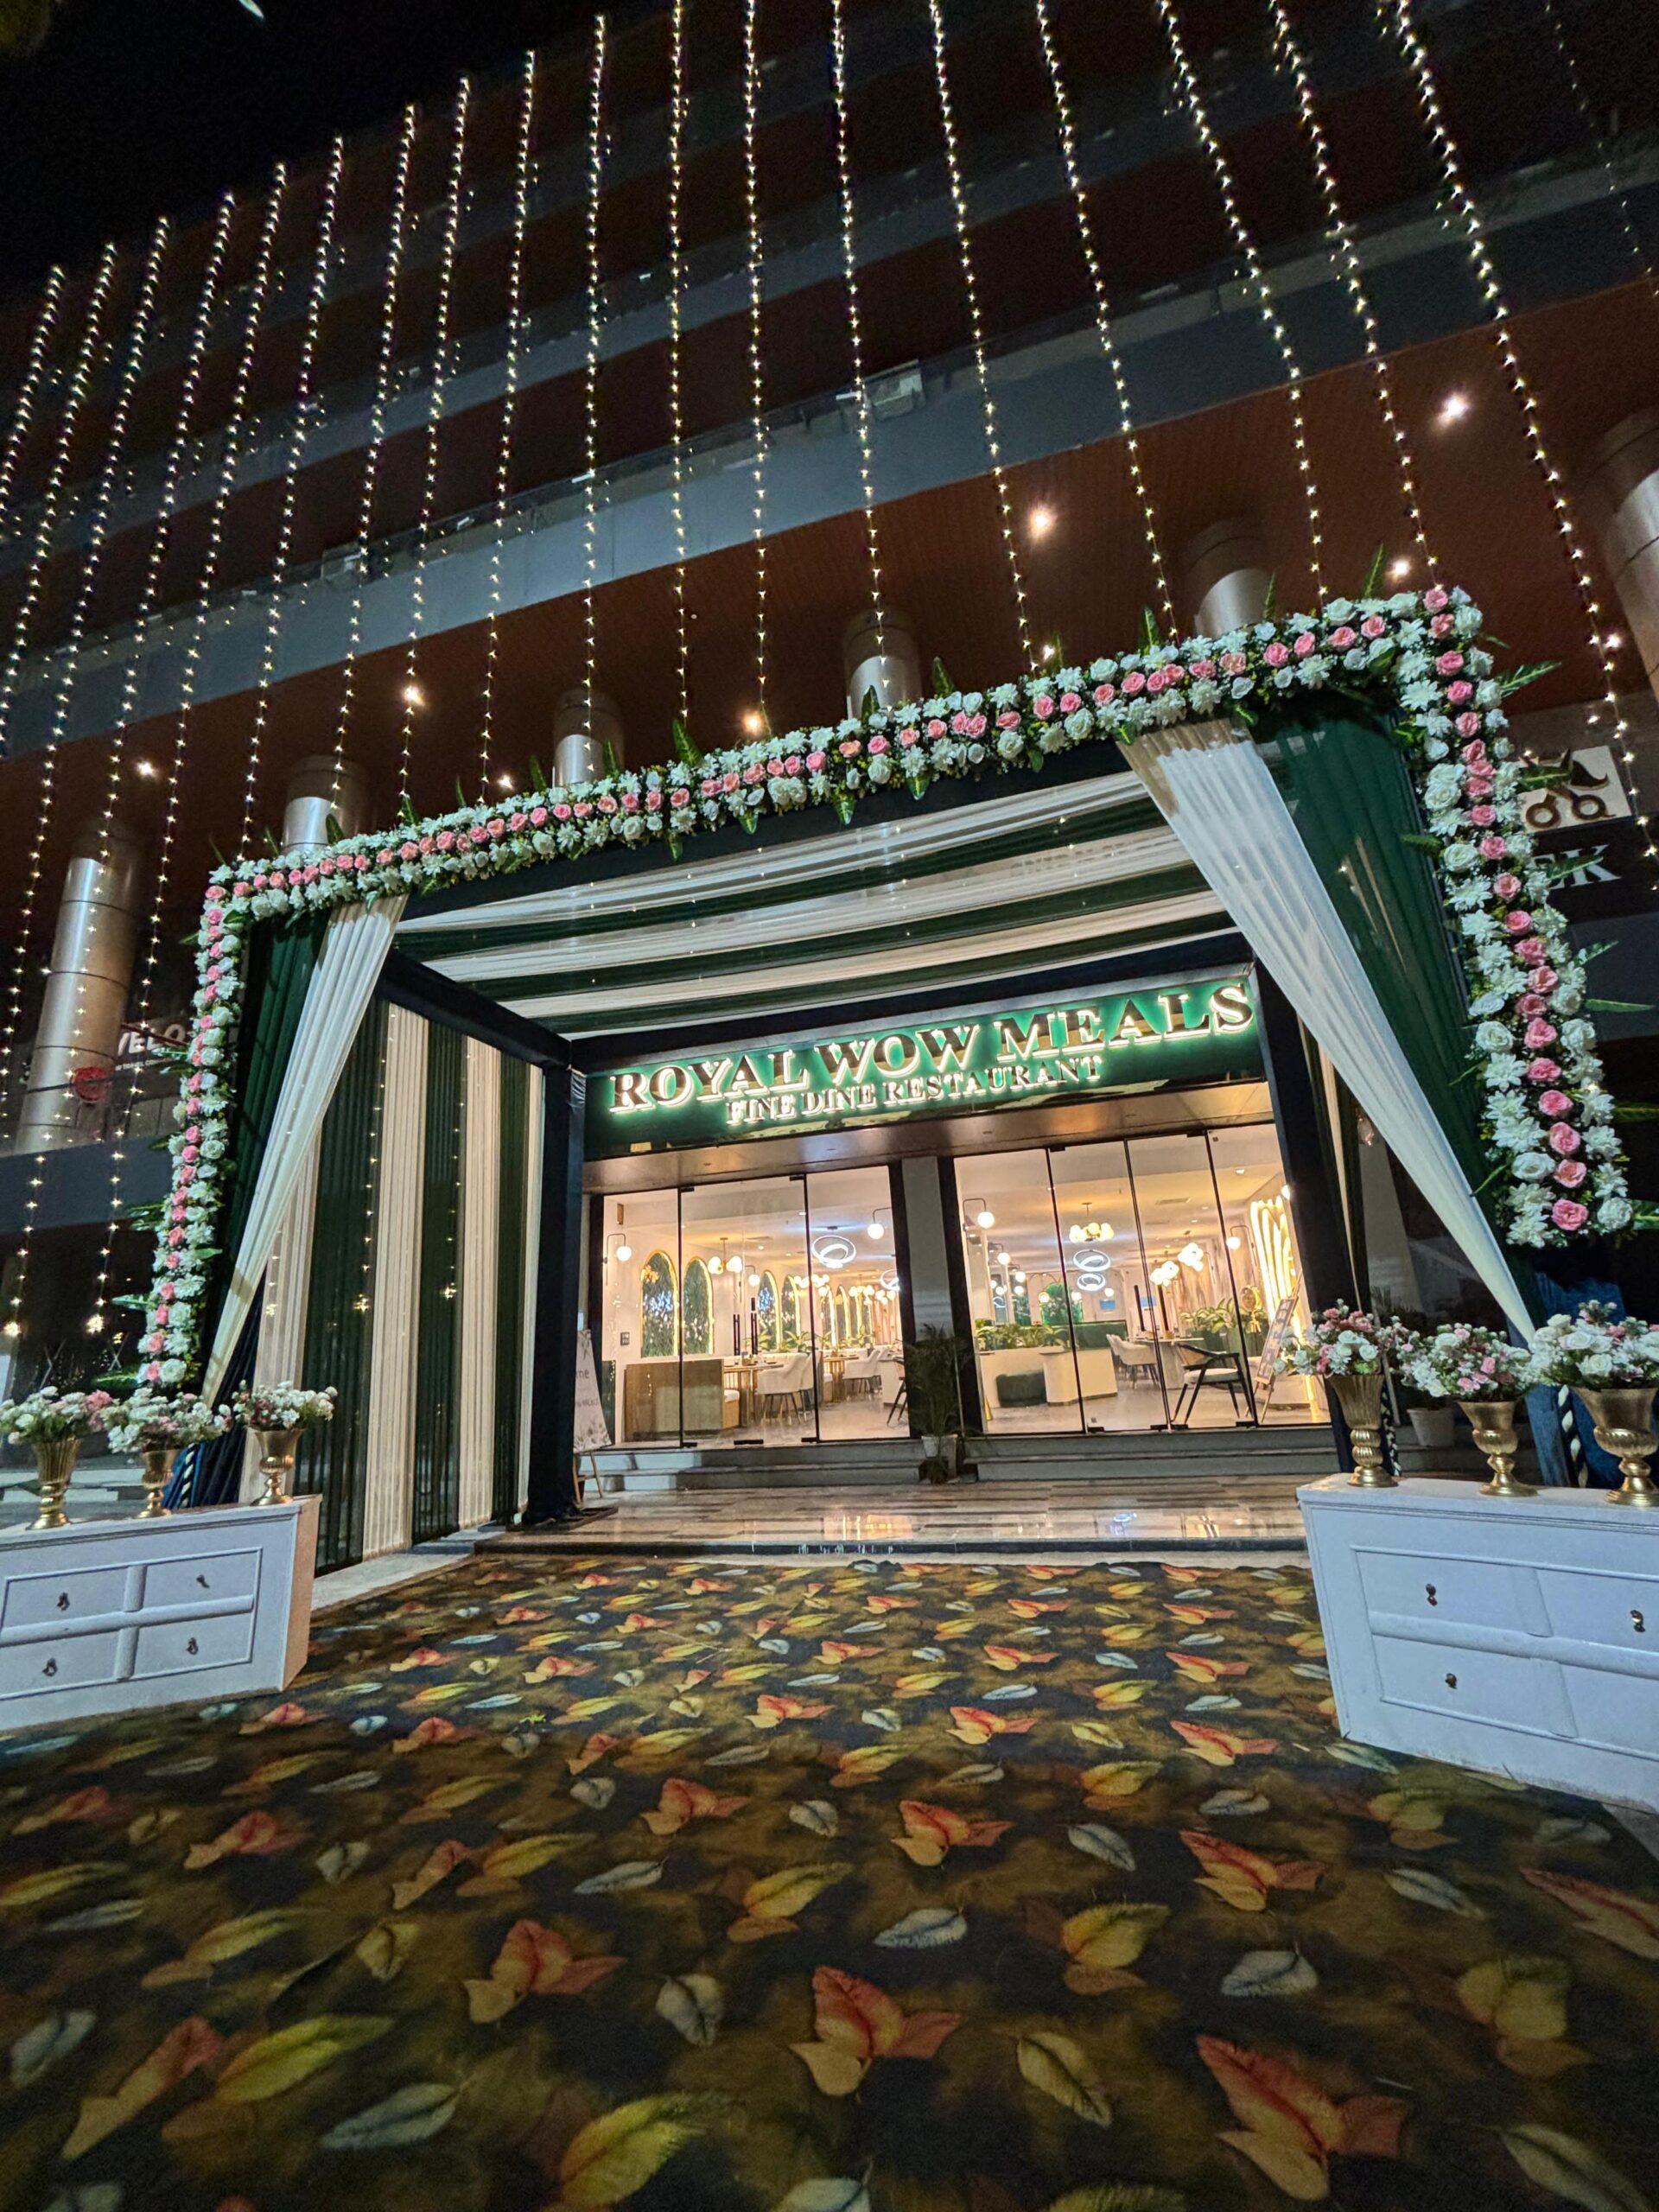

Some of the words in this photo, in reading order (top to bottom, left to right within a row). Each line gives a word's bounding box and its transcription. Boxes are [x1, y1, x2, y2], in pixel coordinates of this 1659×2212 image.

[610, 1049, 810, 1113] ROYAL
[814, 1023, 981, 1086] WOW
[994, 983, 1253, 1063] MEALS
[726, 1093, 797, 1125] FINE
[801, 1083, 878, 1116] DINE
[882, 1054, 1103, 1106] RESTAURANT
